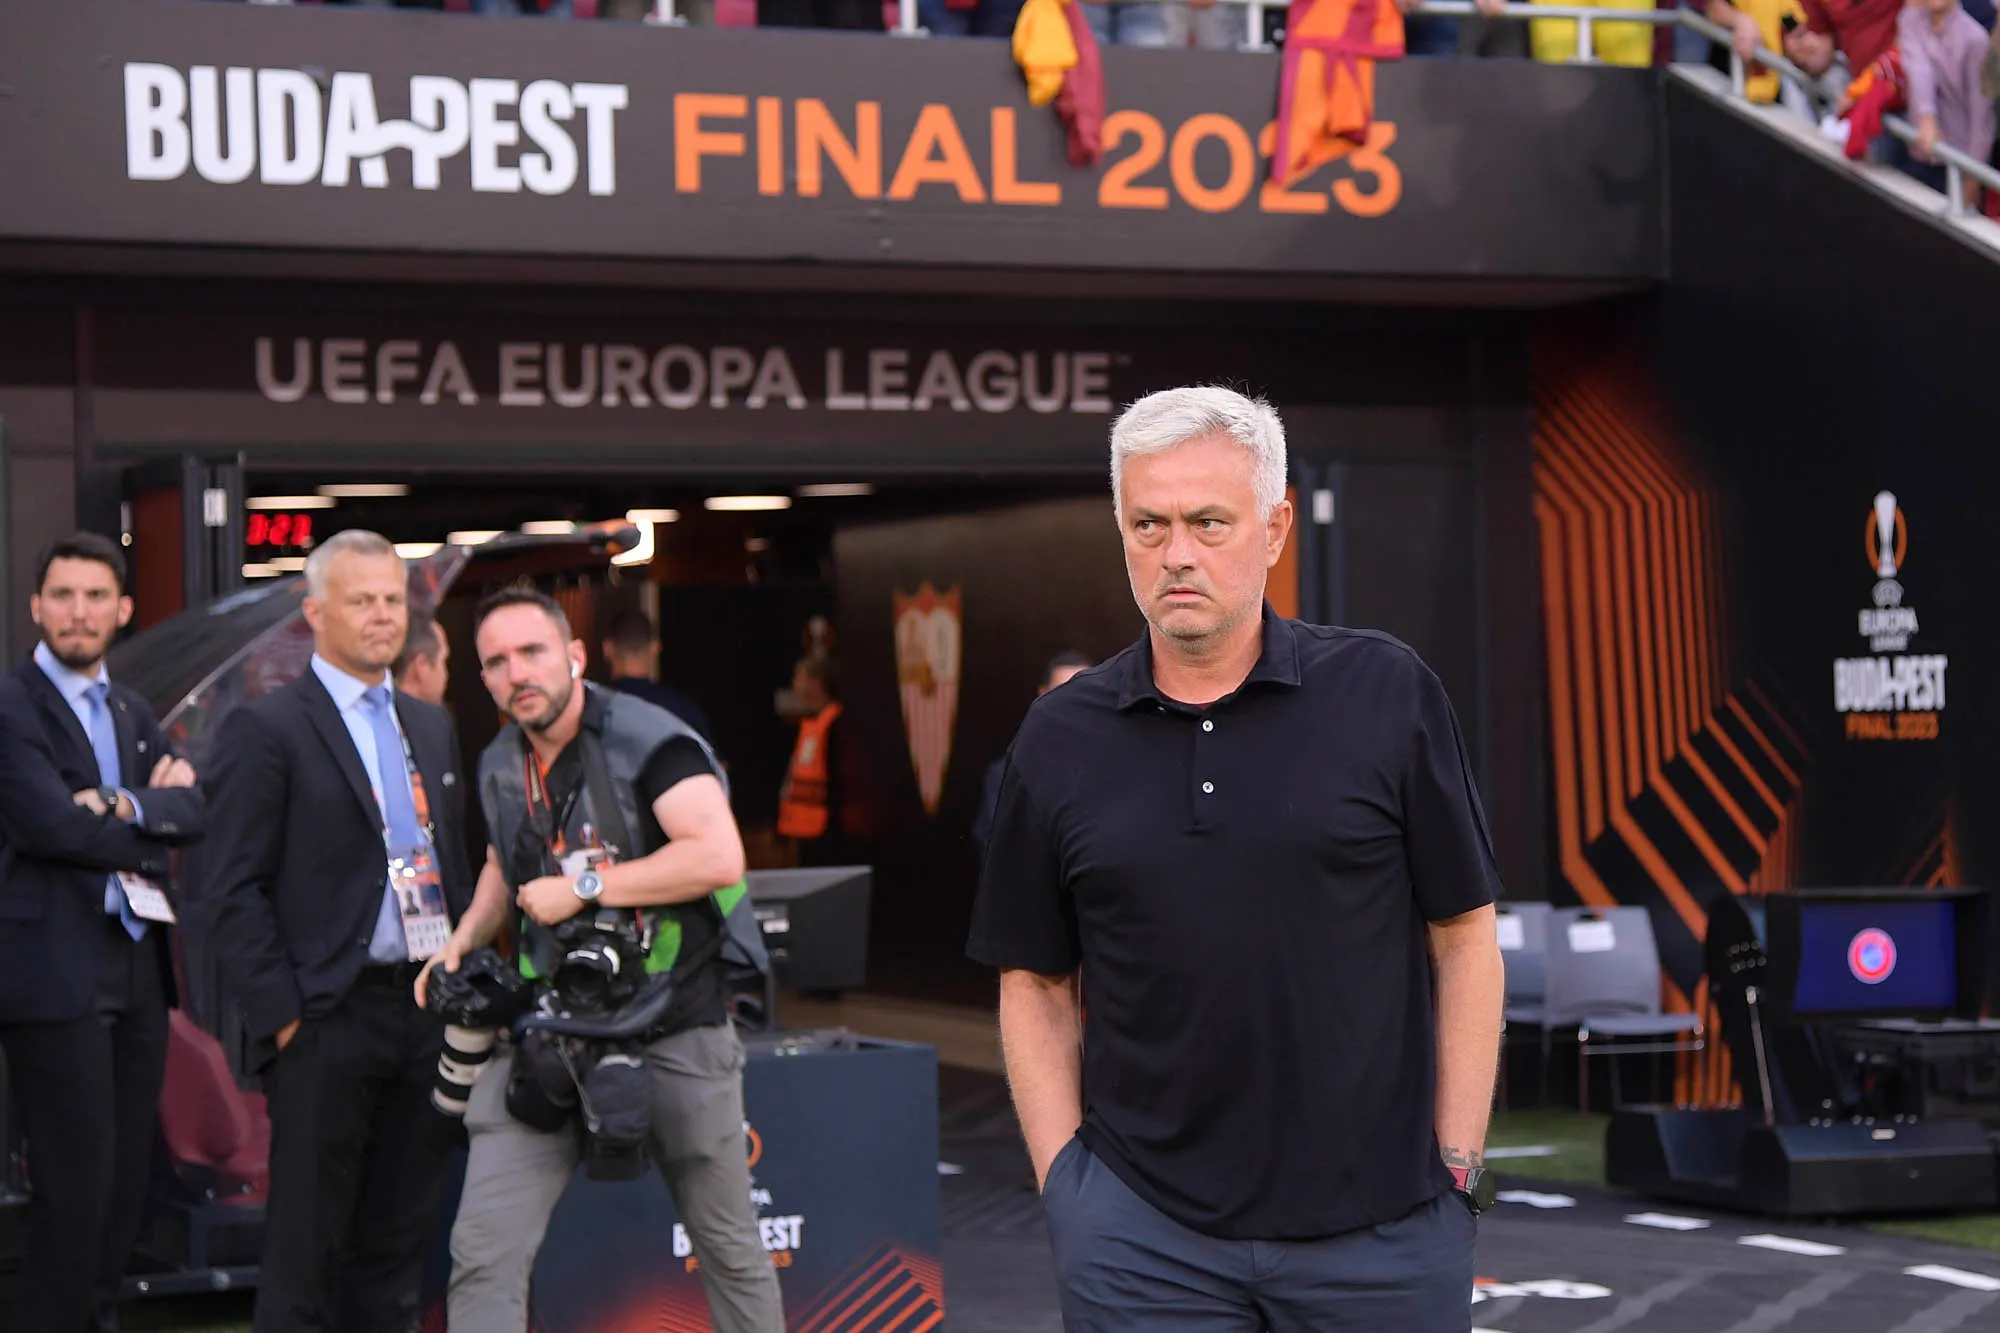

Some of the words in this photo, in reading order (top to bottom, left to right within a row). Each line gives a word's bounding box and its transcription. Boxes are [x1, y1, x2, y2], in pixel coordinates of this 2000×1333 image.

[124, 62, 629, 196] BUDAPEST
[672, 92, 1062, 205] FINAL
[255, 338, 479, 405] UEFA
[499, 343, 807, 410] EUROPA
[825, 348, 1113, 413] LEAGUE
